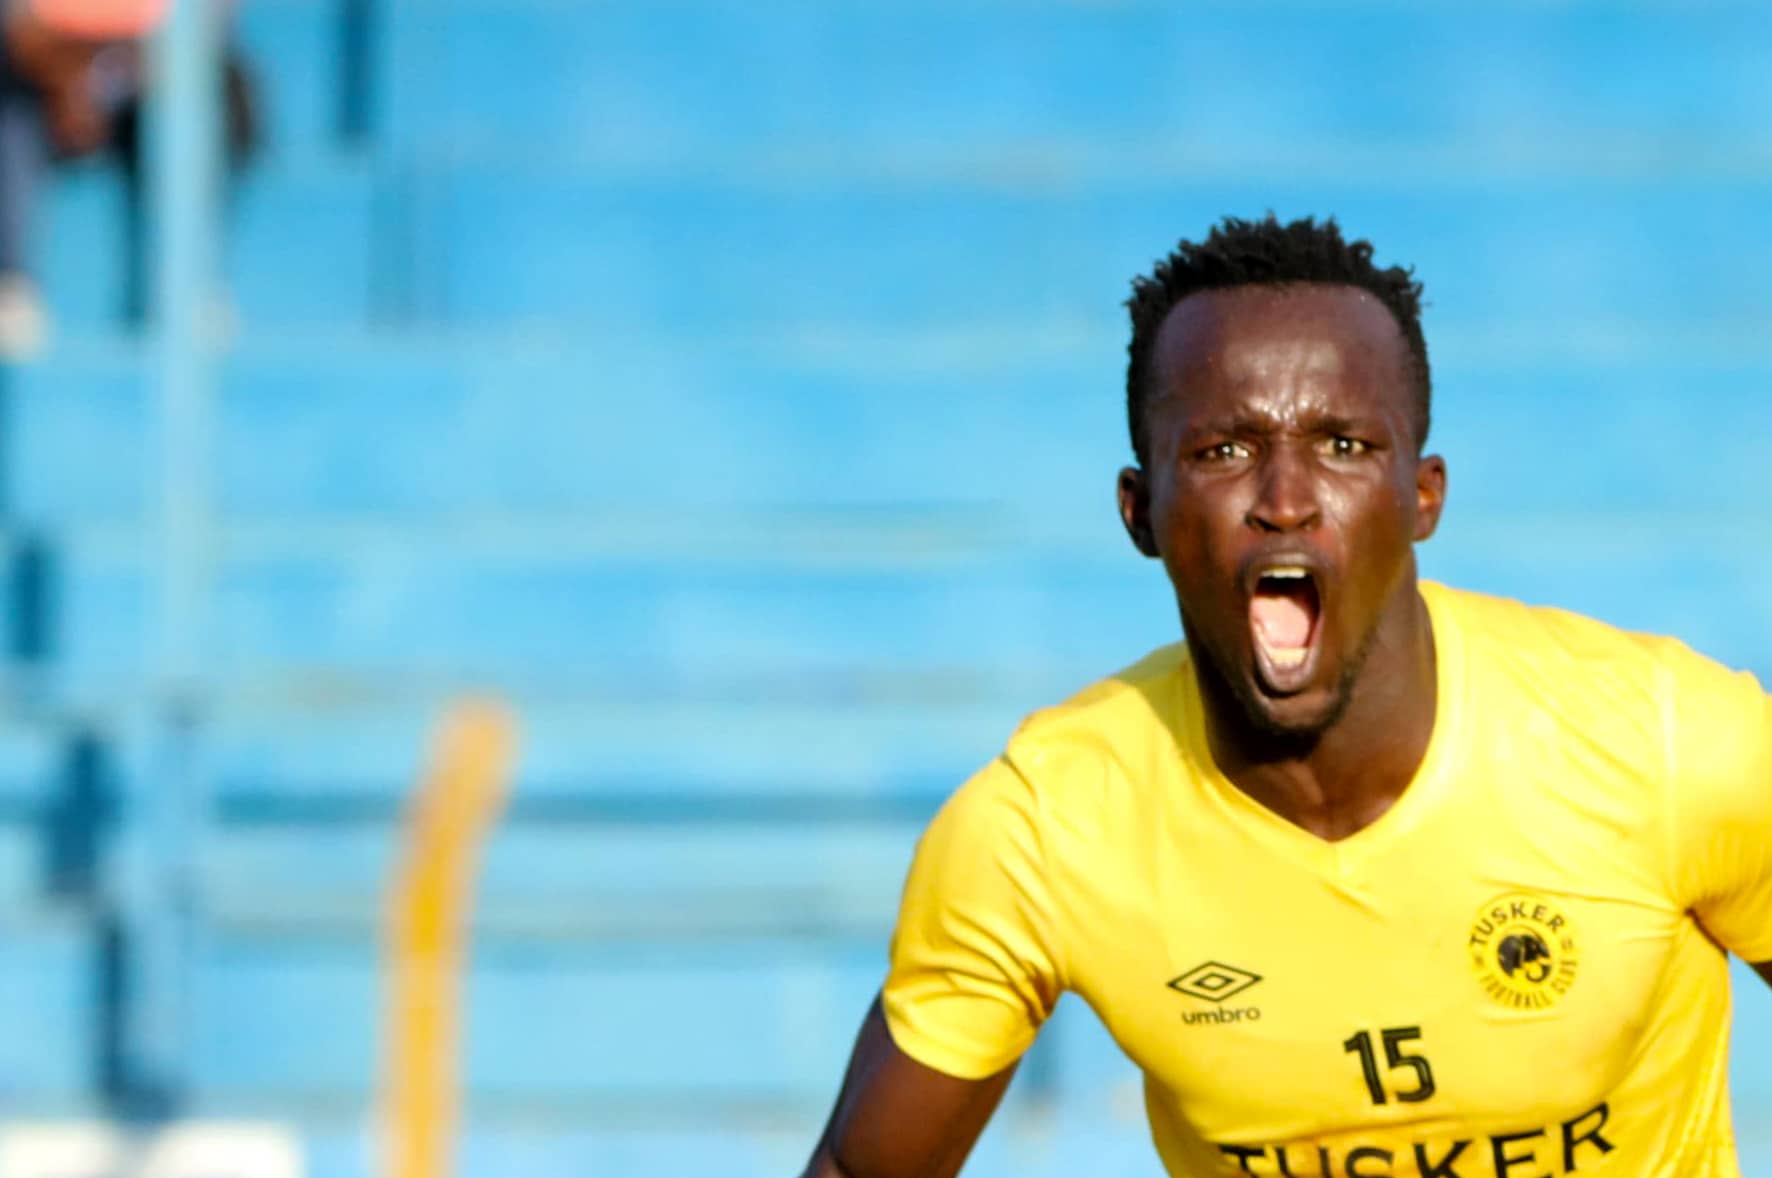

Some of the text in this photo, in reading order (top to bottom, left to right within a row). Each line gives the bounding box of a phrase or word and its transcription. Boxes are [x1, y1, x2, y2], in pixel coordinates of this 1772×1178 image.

[1469, 900, 1565, 947] TUSKER
[1181, 1007, 1261, 1025] umbro
[1343, 1025, 1438, 1106] 15
